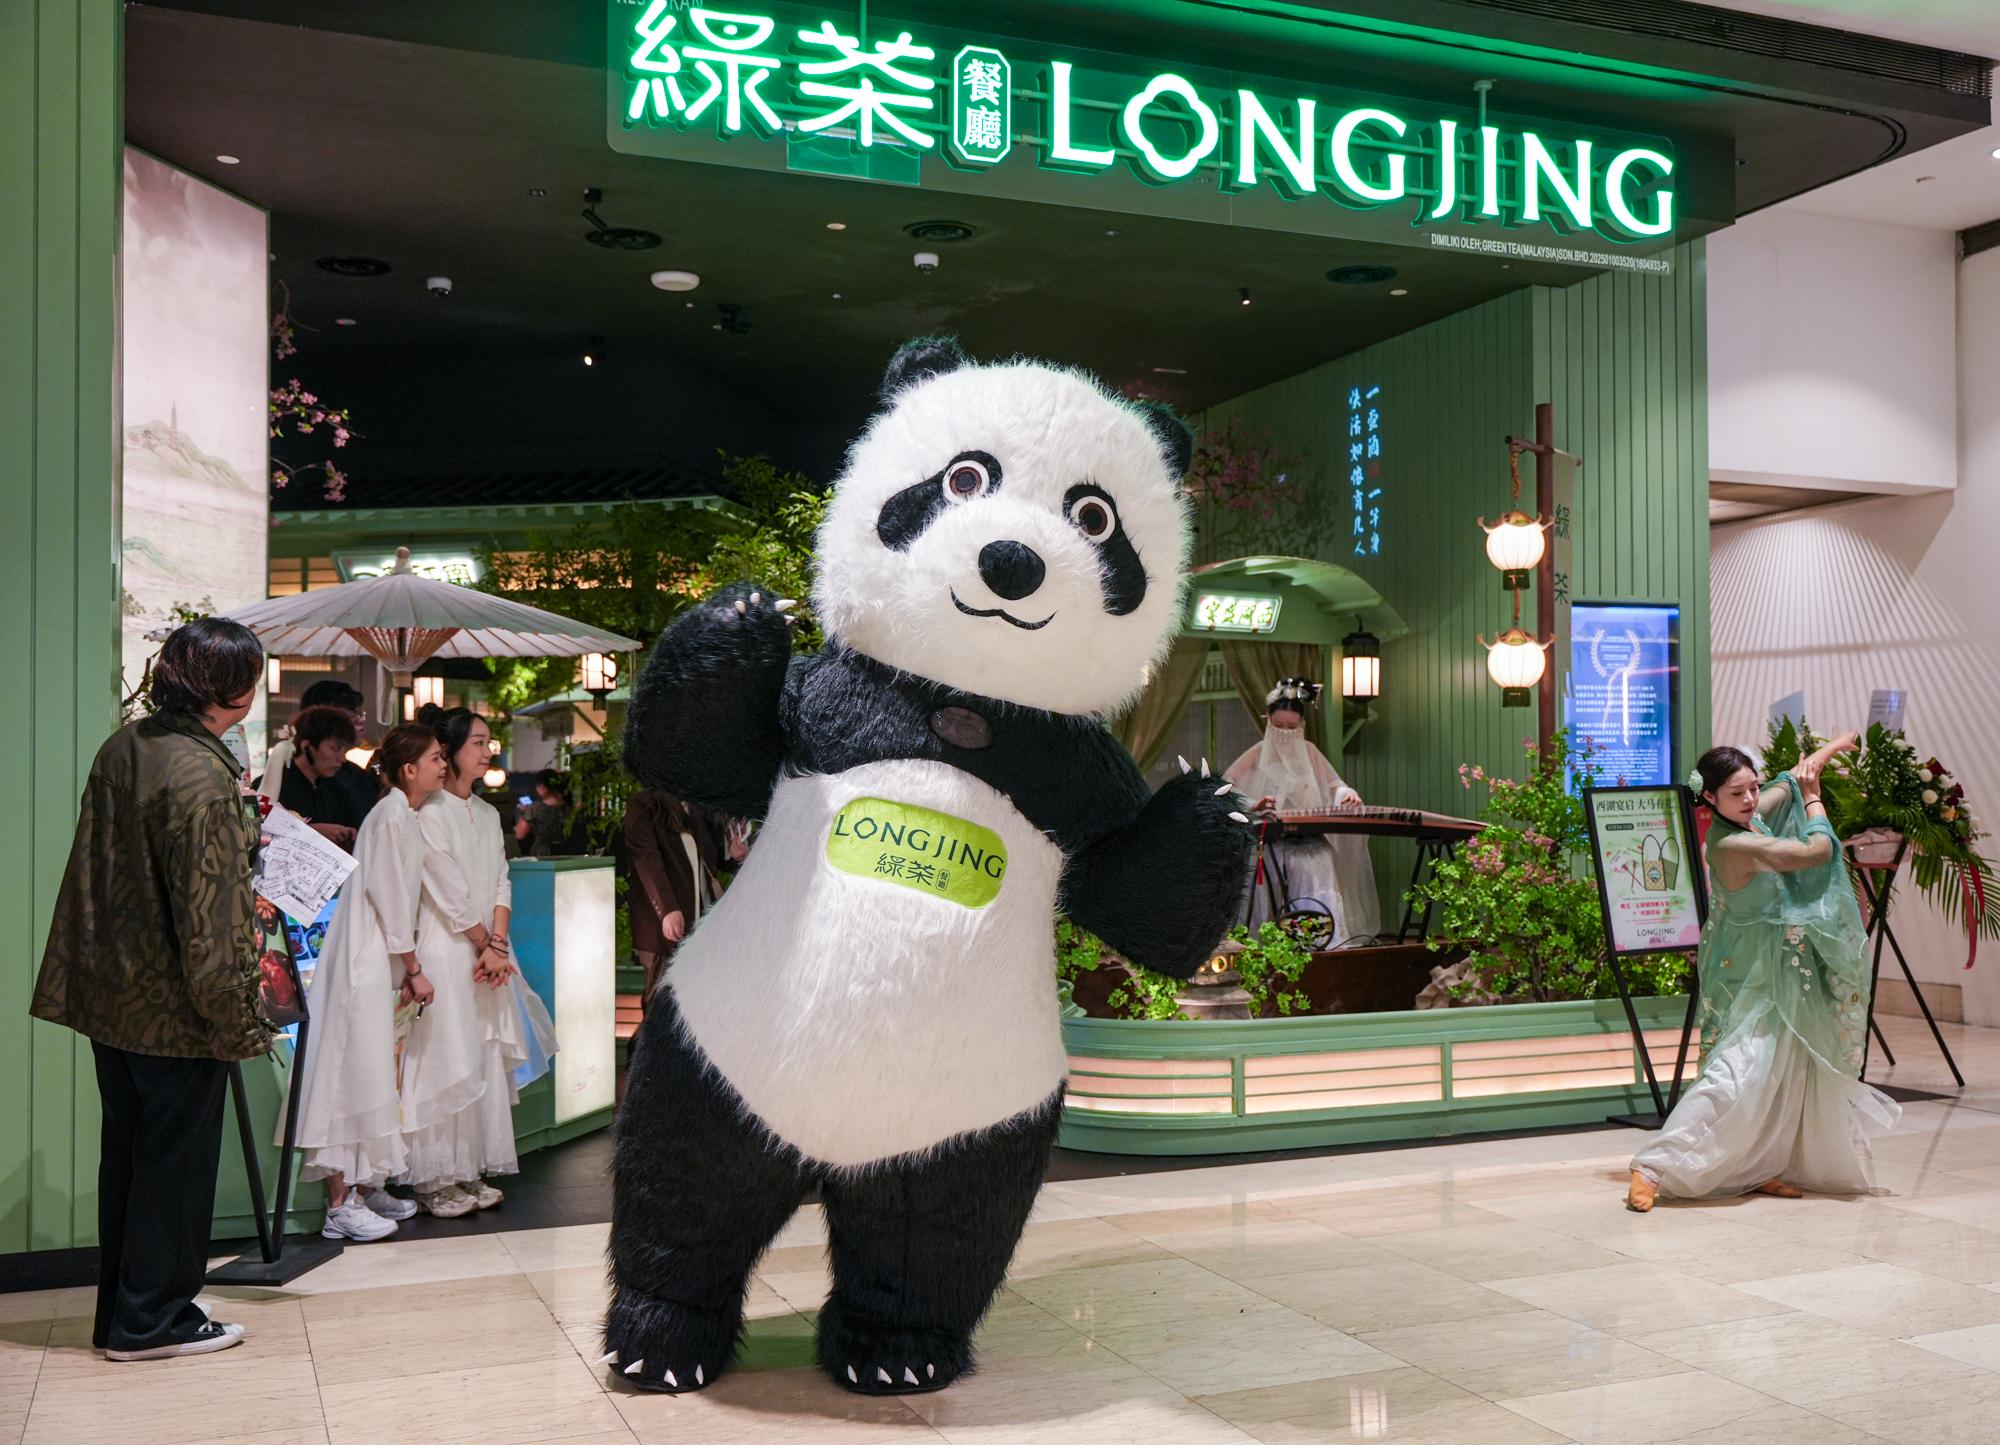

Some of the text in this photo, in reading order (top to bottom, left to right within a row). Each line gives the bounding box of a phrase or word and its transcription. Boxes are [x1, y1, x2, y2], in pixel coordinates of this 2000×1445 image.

[962, 58, 1003, 150] 餐廳
[1050, 60, 1674, 235] LONGJING
[1431, 233, 1460, 248] DIMILIKI
[834, 814, 1005, 879] LONGJING
[1636, 927, 1676, 937] LONGJING
